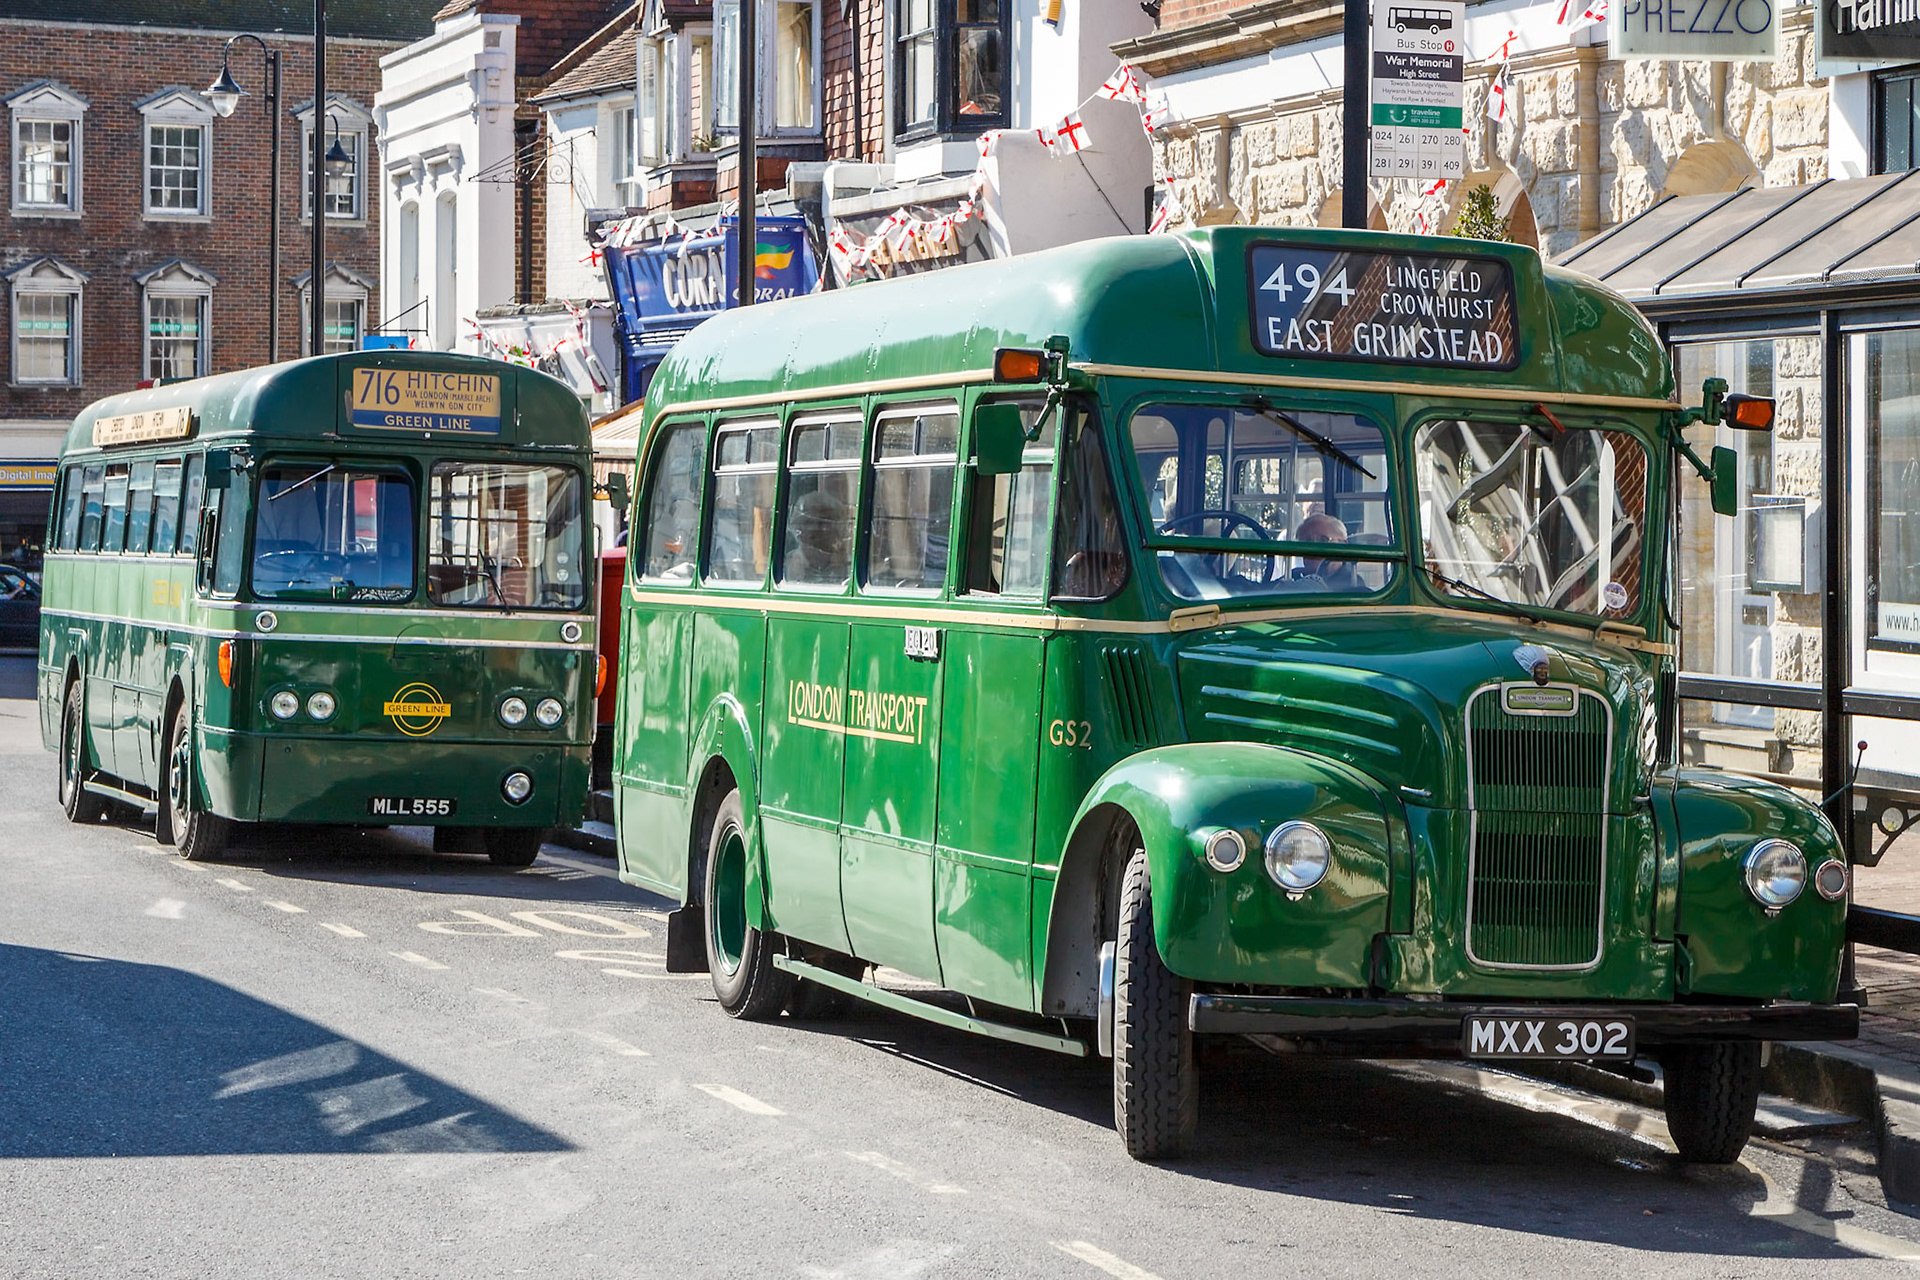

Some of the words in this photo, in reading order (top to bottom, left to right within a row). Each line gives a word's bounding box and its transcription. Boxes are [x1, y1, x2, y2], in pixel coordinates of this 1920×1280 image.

[1624, 0, 1771, 34] PREZZO
[1397, 39, 1415, 49] Bus
[1420, 40, 1442, 51] Stop
[1385, 55, 1407, 66] War
[1410, 56, 1453, 68] Memorial
[1400, 69, 1416, 79] High
[1418, 70, 1440, 79] Street
[1411, 109, 1440, 117] traveline
[1375, 131, 1392, 140] 024
[1399, 134, 1415, 144] 261
[1421, 135, 1439, 145] 270
[1444, 136, 1461, 146] 280
[1375, 158, 1391, 168] 281
[1398, 159, 1414, 169] 291
[1421, 160, 1437, 169] 391
[1443, 161, 1460, 170] 409
[1260, 263, 1355, 306] 494
[1386, 266, 1481, 293] LINGFIELD
[1380, 293, 1494, 320] CROWHURST
[1267, 317, 1334, 353] EAST
[1354, 323, 1502, 363] GRINSTEAD
[360, 370, 400, 405] 716
[408, 372, 492, 393] HITCHIN
[405, 390, 417, 398] VIA
[420, 391, 448, 400] LONDON
[414, 400, 445, 409] WELWYN
[448, 402, 464, 410] GDN
[467, 403, 483, 411] CITY
[384, 414, 433, 428] GREEN
[439, 417, 471, 430] LINE
[0, 470, 31, 482] Digital
[1885, 612, 1920, 632] www.h
[388, 704, 420, 713] GREEN
[425, 705, 446, 713] LINE
[788, 680, 842, 723] LONDON
[849, 689, 927, 744] TRANSPORT
[1050, 719, 1092, 747] GS2
[1471, 1020, 1546, 1053] MXX
[1555, 1021, 1628, 1055] 302
